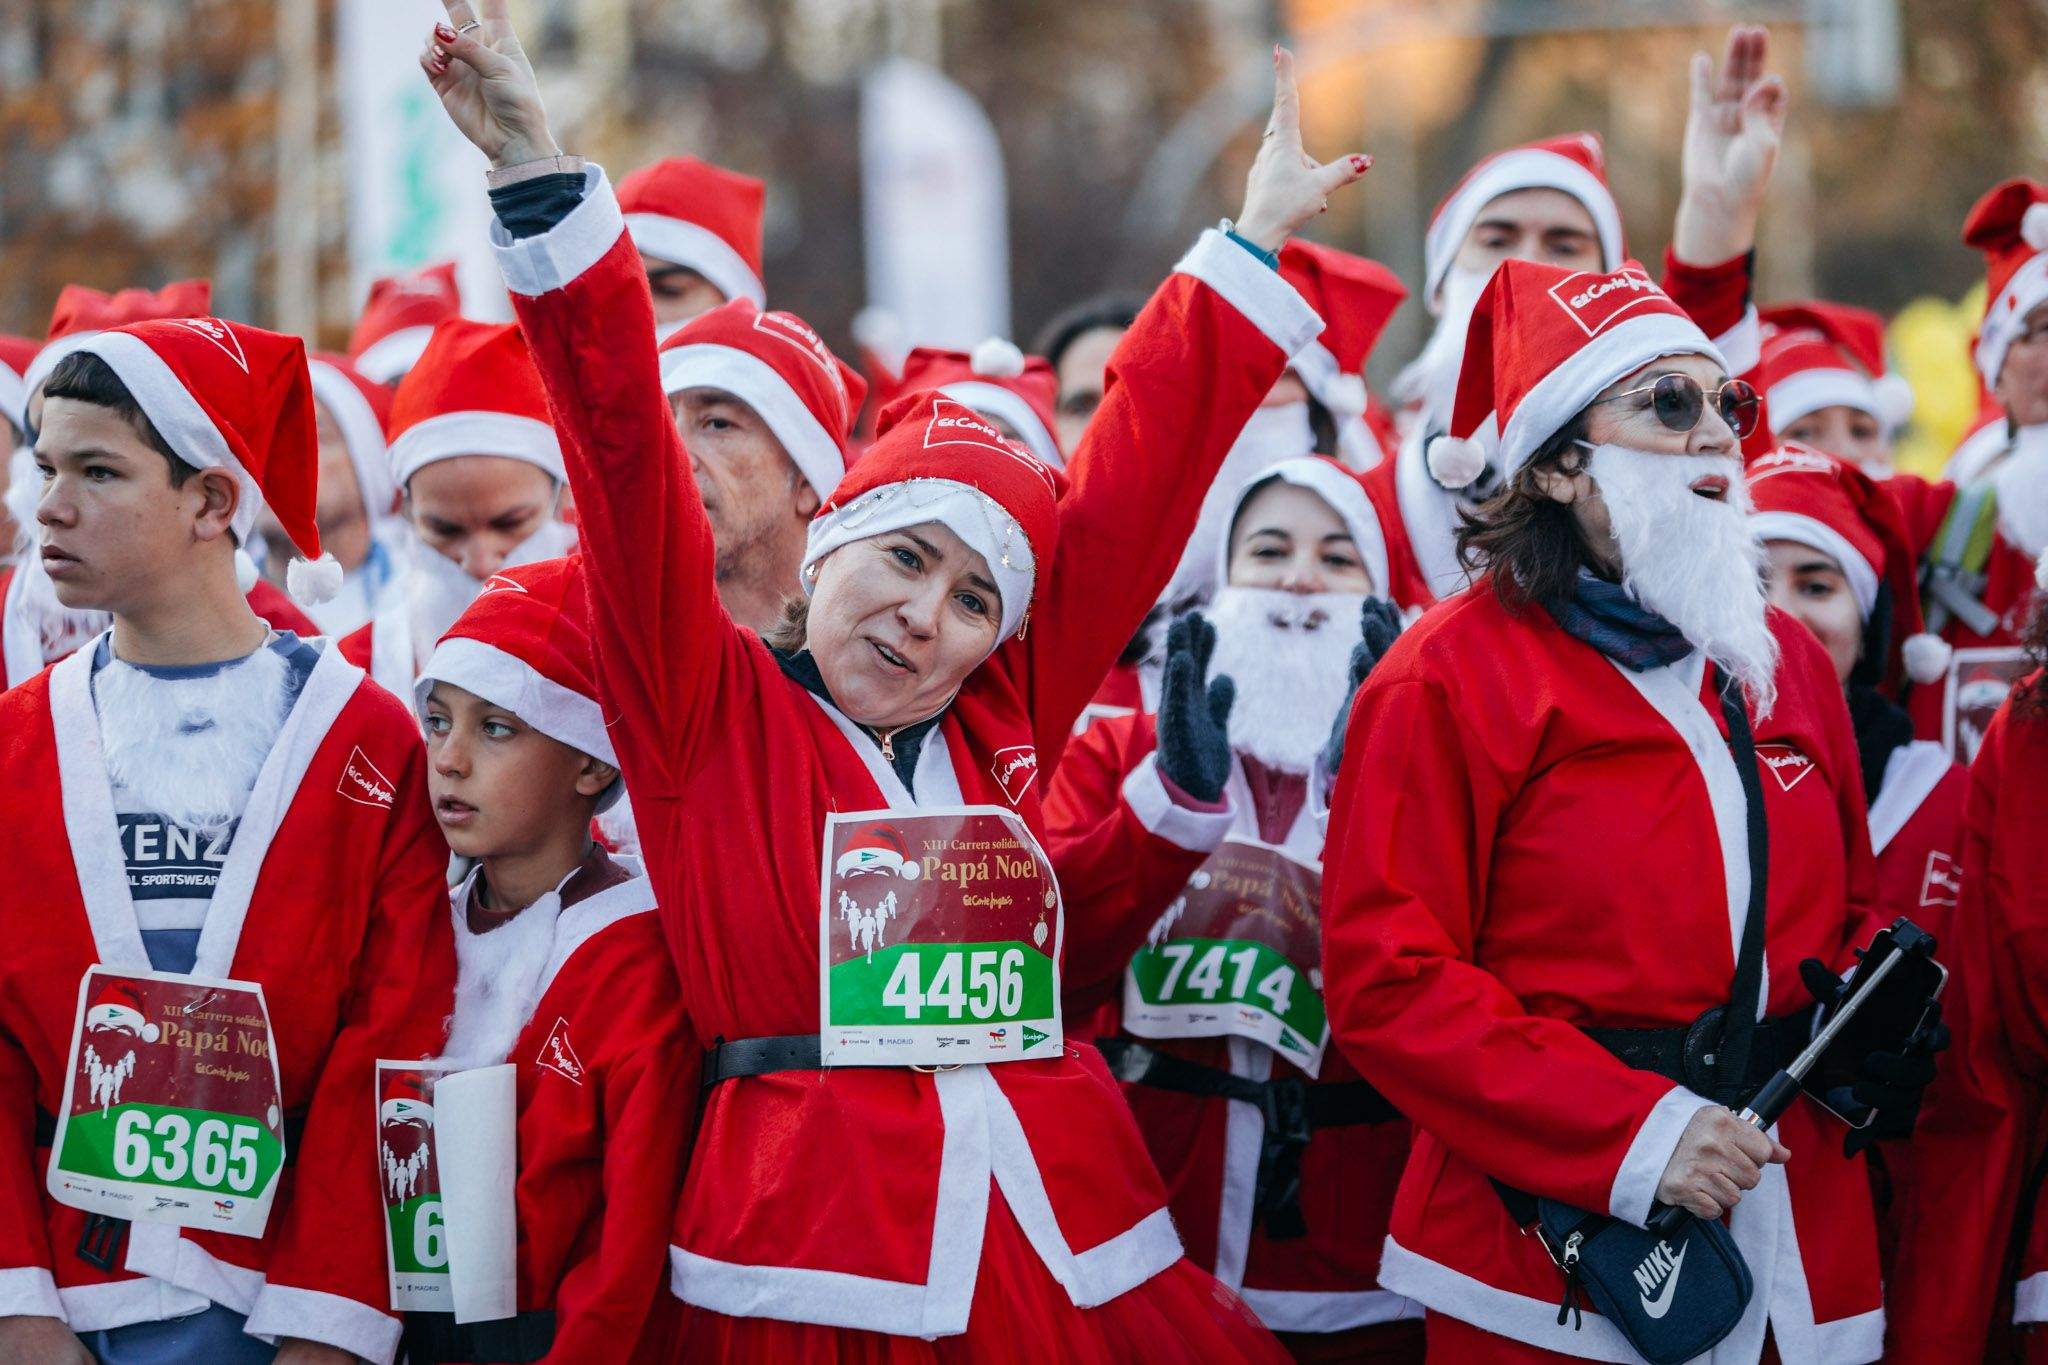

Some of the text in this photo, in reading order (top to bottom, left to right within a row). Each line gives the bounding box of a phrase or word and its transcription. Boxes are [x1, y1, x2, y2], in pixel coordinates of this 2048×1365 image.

[922, 853, 1039, 889] Papá Noel
[923, 839, 947, 851] XIII
[951, 839, 991, 851] Carrera
[882, 948, 1025, 1019] 4456
[1158, 944, 1296, 1016] 7414
[159, 1021, 229, 1057] Papá
[113, 1109, 260, 1192] 6365
[1633, 1239, 1679, 1296] NIKE
